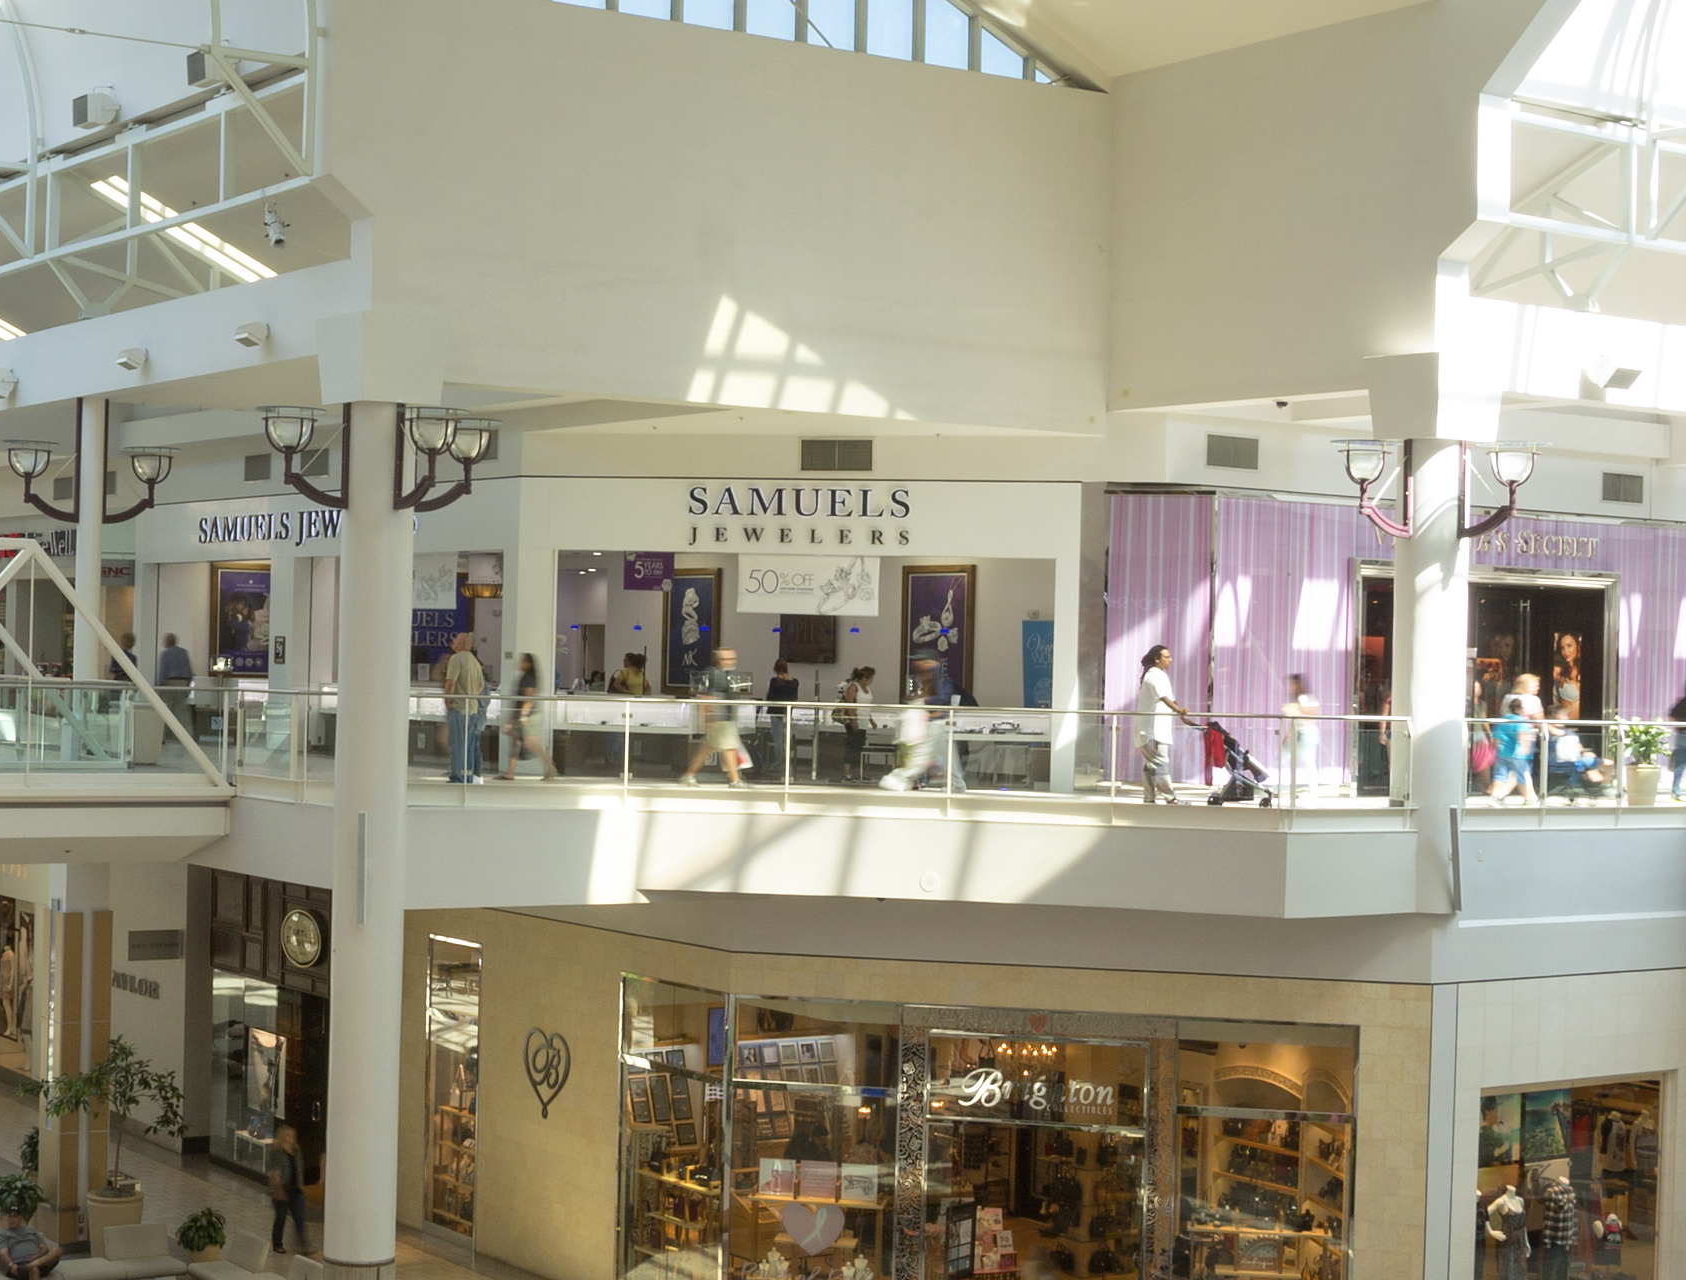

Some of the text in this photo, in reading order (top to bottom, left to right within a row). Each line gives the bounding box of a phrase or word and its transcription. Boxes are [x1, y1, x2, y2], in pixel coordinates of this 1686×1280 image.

[688, 486, 911, 518] SAMUELS
[198, 511, 291, 544] SAMUELS
[688, 526, 911, 546] JEWELERS
[634, 561, 644, 578] 5
[791, 573, 815, 587] OFF
[958, 1068, 1115, 1110] Brighton
[1046, 1101, 1114, 1115] COLLECTIBLES
